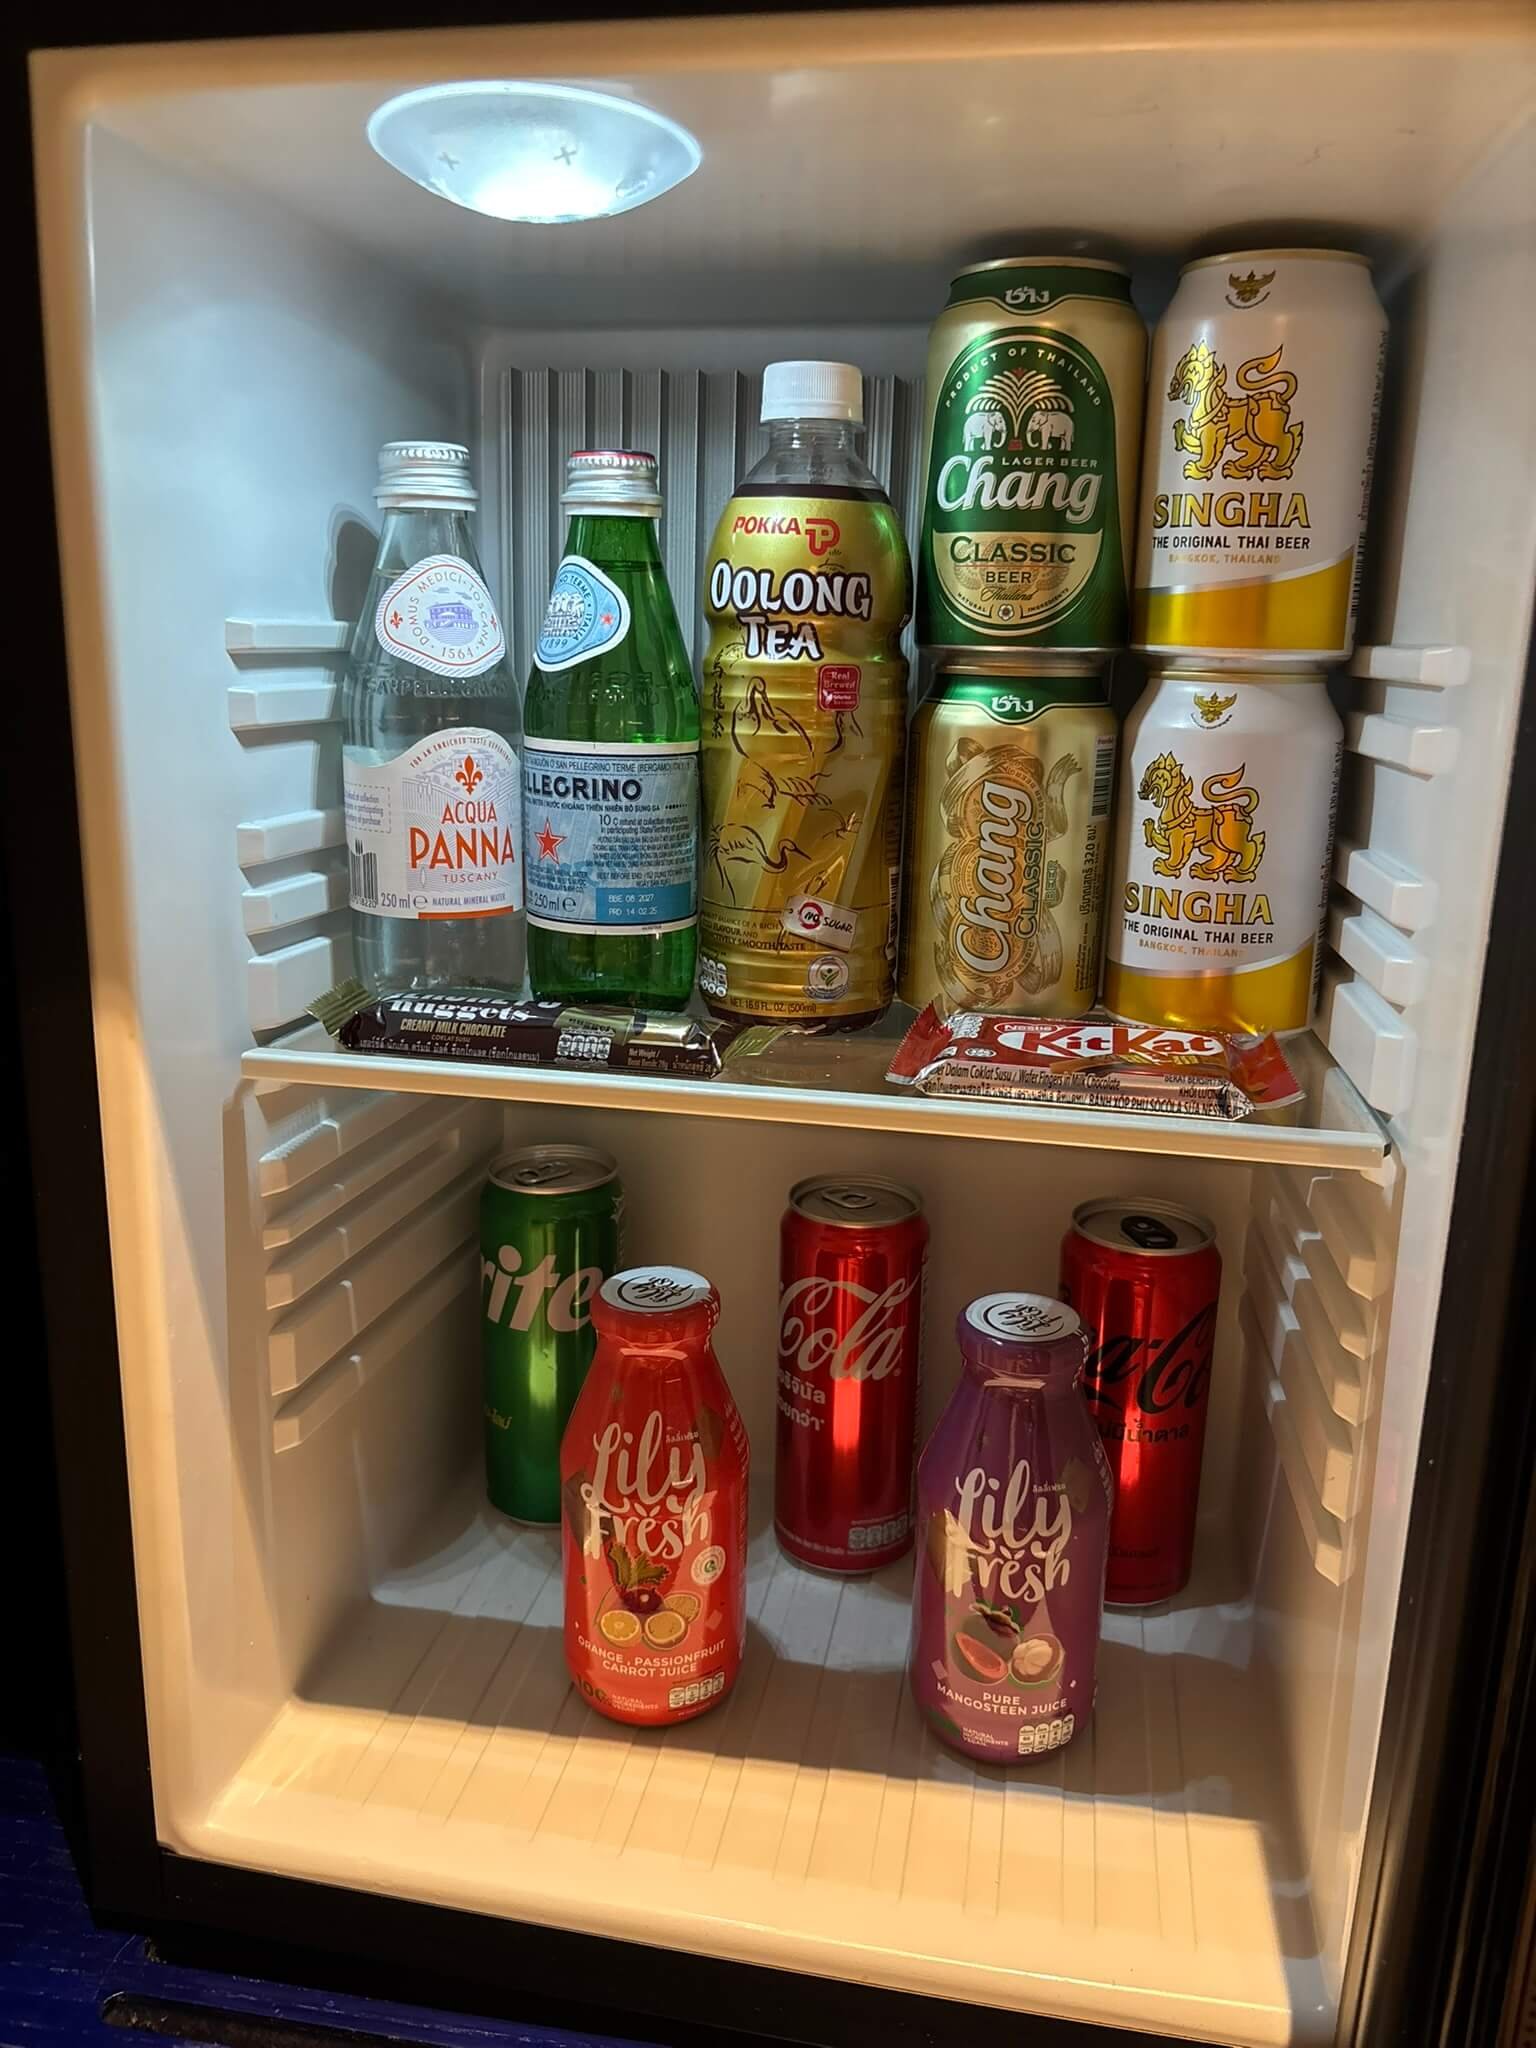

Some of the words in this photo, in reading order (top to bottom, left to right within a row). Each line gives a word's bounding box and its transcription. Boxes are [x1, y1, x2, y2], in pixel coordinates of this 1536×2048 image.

[945, 353, 999, 408] PRODUCT
[1008, 347, 1027, 357] OF
[1037, 348, 1101, 406] THAILAND
[1002, 456, 1055, 468] LAGER
[1060, 457, 1099, 470] BEER
[937, 454, 1104, 525] Chang
[1152, 492, 1311, 530] SINGHA
[733, 516, 801, 535] POKKA
[950, 535, 1076, 565] CLASSIC
[1152, 535, 1168, 550] THE
[1172, 535, 1231, 550] ORIGINAL
[1237, 535, 1270, 550] THAI
[1275, 535, 1310, 550] BEER
[1223, 553, 1281, 565] THAILAND
[417, 571, 462, 593] MEDICI
[570, 575, 592, 599] TERME
[985, 571, 1032, 584] BEER
[709, 560, 873, 622] OOLONG
[408, 596, 430, 646] DOMUS
[573, 612, 593, 641] ITALIA
[738, 613, 824, 661] TEA
[569, 760, 611, 773] PELLEGRINO
[612, 763, 637, 773] TERME
[441, 801, 499, 825] ACQUA
[599, 814, 611, 826] 10
[409, 825, 516, 870] PANNA
[1084, 843, 1096, 865] 320
[443, 871, 499, 884] TUSCANY
[955, 780, 1033, 973] Chang
[1013, 821, 1047, 940] CLASSIC
[381, 892, 397, 908] 250
[399, 893, 412, 910] ml
[1124, 882, 1274, 924] SINGHA
[803, 911, 821, 923] NO
[823, 917, 854, 934] SUGAR
[1124, 918, 1139, 933] THE
[1143, 923, 1199, 942] ORIGINAL
[1204, 931, 1235, 944] THAI
[1240, 933, 1273, 944] BEER
[1138, 940, 1188, 954] BANGKOK,
[390, 1000, 533, 1022] nuggets
[400, 1018, 436, 1032] CREAMY
[436, 1020, 458, 1035] MILK
[458, 1022, 508, 1038] CHOCOLATE
[1022, 1027, 1213, 1060] KitKat
[945, 1063, 969, 1078] Dalam
[969, 1065, 994, 1080] Coklat
[994, 1067, 1012, 1082] Susu
[1019, 1069, 1039, 1085] Wafer
[580, 1410, 709, 1514] Lily
[954, 1460, 1072, 1556] Lily
[584, 1500, 710, 1560] Fresh
[944, 1540, 1071, 1602] Fresh
[577, 1635, 624, 1664] ORANGE
[634, 1638, 726, 1667] PASSIONFRUIT
[602, 1659, 657, 1677] CARROT
[659, 1662, 697, 1677] JUICE
[937, 1682, 1028, 1716] MANGOSTEEN
[1031, 1697, 1068, 1715] JUICE
[982, 1692, 1021, 1706] PURE
